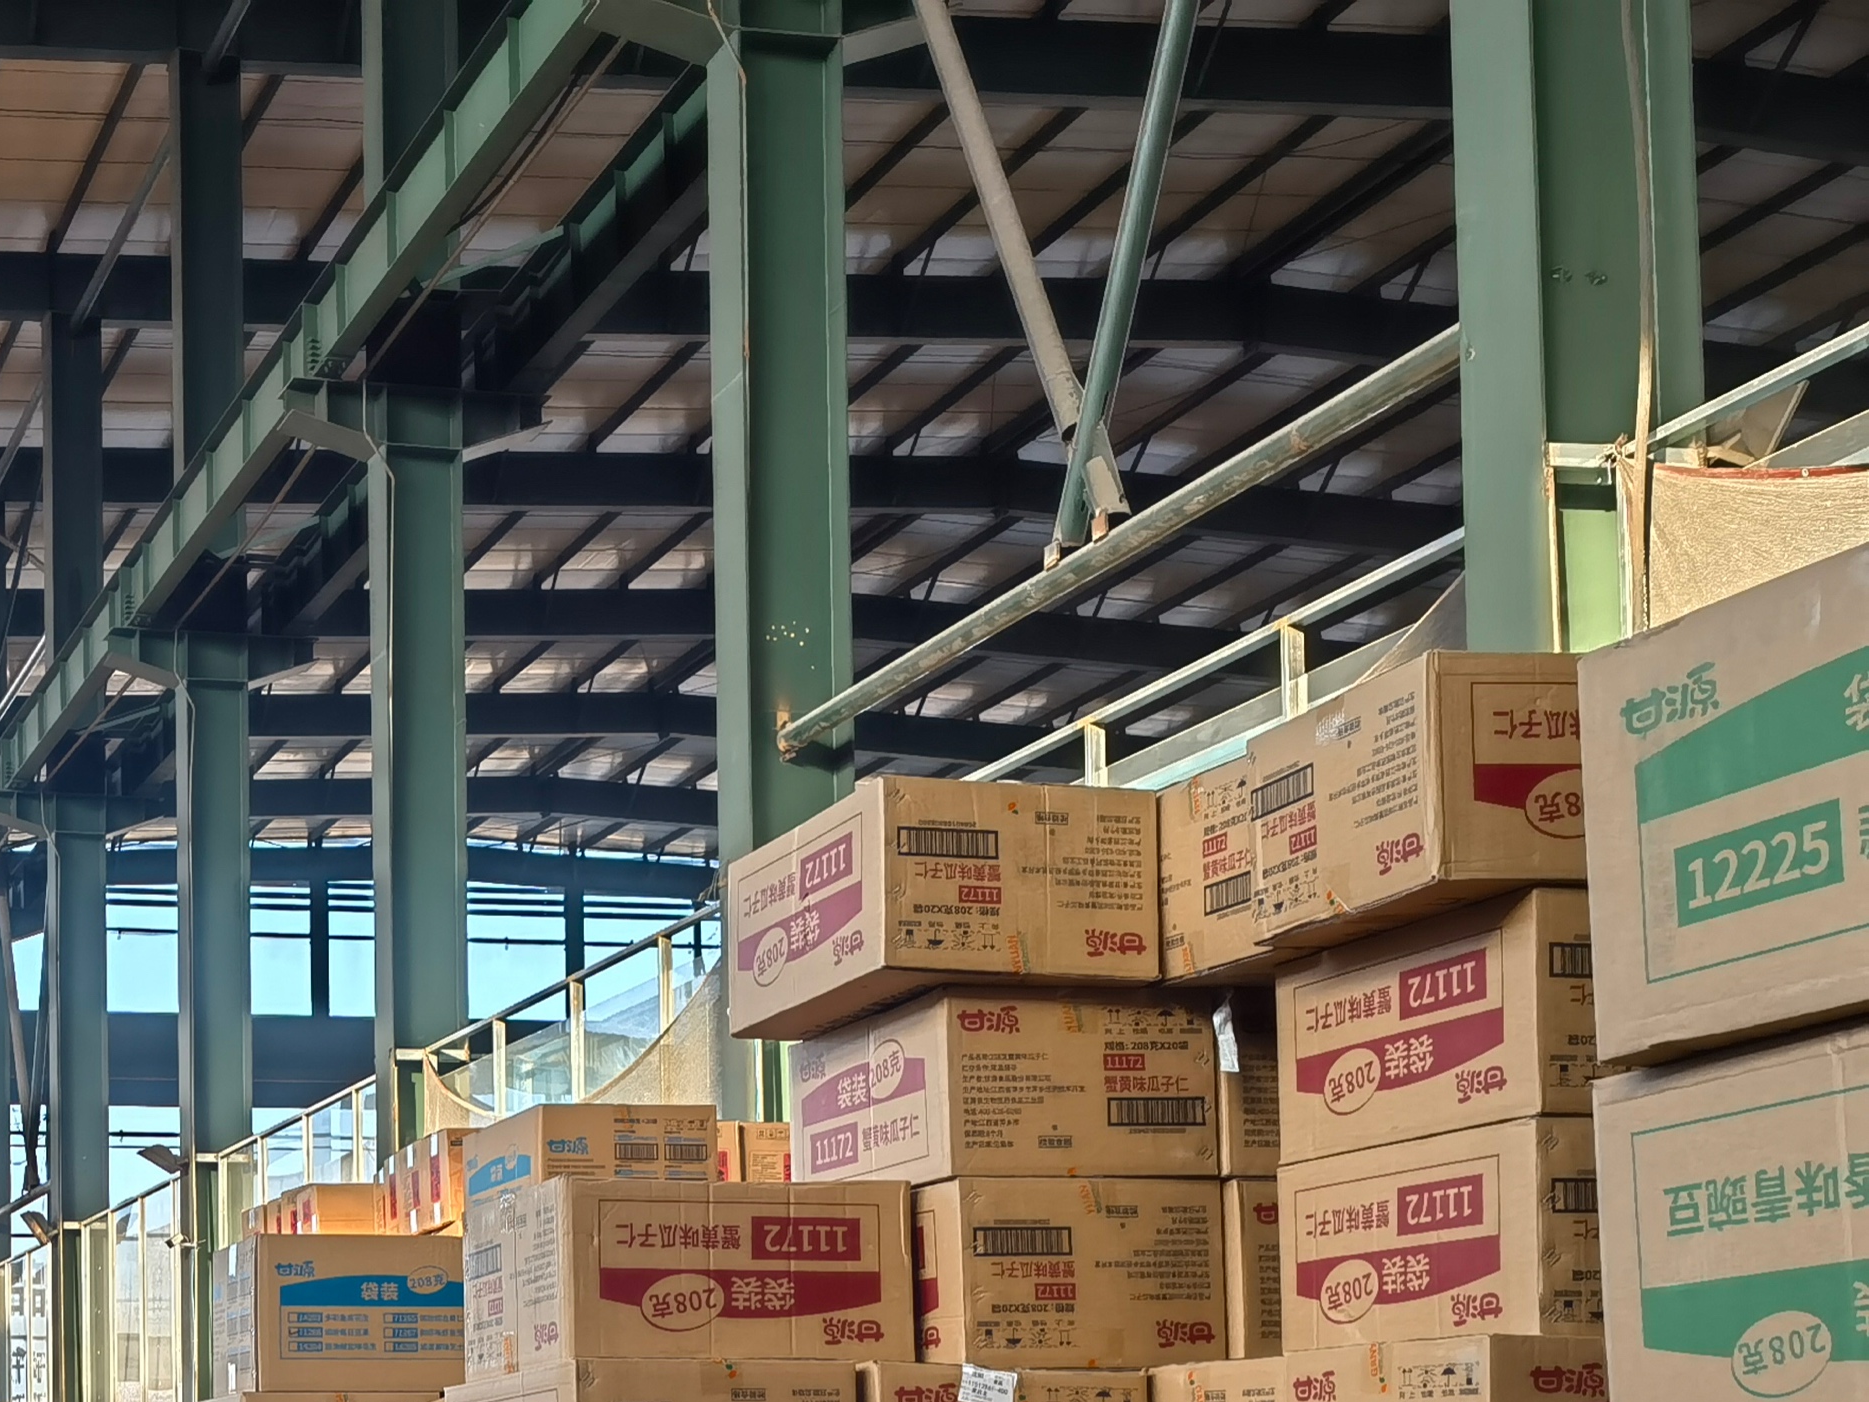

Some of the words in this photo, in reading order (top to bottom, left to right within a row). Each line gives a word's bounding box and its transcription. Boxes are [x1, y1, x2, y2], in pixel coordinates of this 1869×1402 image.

[1621, 661, 1720, 736] 甘源
[805, 843, 846, 886] 11172
[914, 862, 1001, 882] 蟹黄味瓜子仁
[1376, 832, 1424, 876] 甘源
[1687, 820, 1829, 909] 12225
[960, 888, 998, 901] 11172
[757, 937, 784, 978] 208克
[833, 929, 864, 965] 甘源
[1084, 929, 1147, 957] 甘源
[1407, 960, 1477, 1007] 11172
[957, 1005, 1021, 1034] 甘源
[1306, 985, 1392, 1033] 蟹黄味瓜子仁
[1105, 1055, 1144, 1069] 11172
[1384, 1033, 1434, 1081] 袋装
[837, 1075, 868, 1108] 袋装
[871, 1050, 902, 1089] 208克
[1103, 1075, 1190, 1093] 蟹黄味瓜子仁
[1329, 1061, 1376, 1104] 208克
[1454, 1065, 1508, 1105] 甘源
[815, 1133, 853, 1167] 11172
[862, 1114, 920, 1152] 蟹黄味瓜子仁
[1304, 1199, 1391, 1239] 蟹黄味瓜子仁
[1405, 1185, 1474, 1227] 11172
[615, 1223, 742, 1250] 蟹黄味瓜子仁
[763, 1224, 848, 1253] 11172
[274, 1260, 316, 1278] 甘源
[991, 1260, 1076, 1278] 蟹黄味瓜子仁
[1382, 1253, 1430, 1296] 袋装
[361, 1281, 399, 1301] 袋装
[409, 1274, 447, 1289] 208克
[649, 1285, 718, 1320] 208克
[730, 1276, 796, 1311] 袋装
[1036, 1284, 1075, 1298] 11172
[1325, 1272, 1374, 1312] 208克
[1451, 1290, 1503, 1327] 甘源
[822, 1317, 885, 1346] 甘源
[1156, 1319, 1216, 1348] 甘源
[1738, 1323, 1827, 1376] 208克
[1293, 1370, 1337, 1402] 甘源
[1530, 1362, 1607, 1397] 甘源
